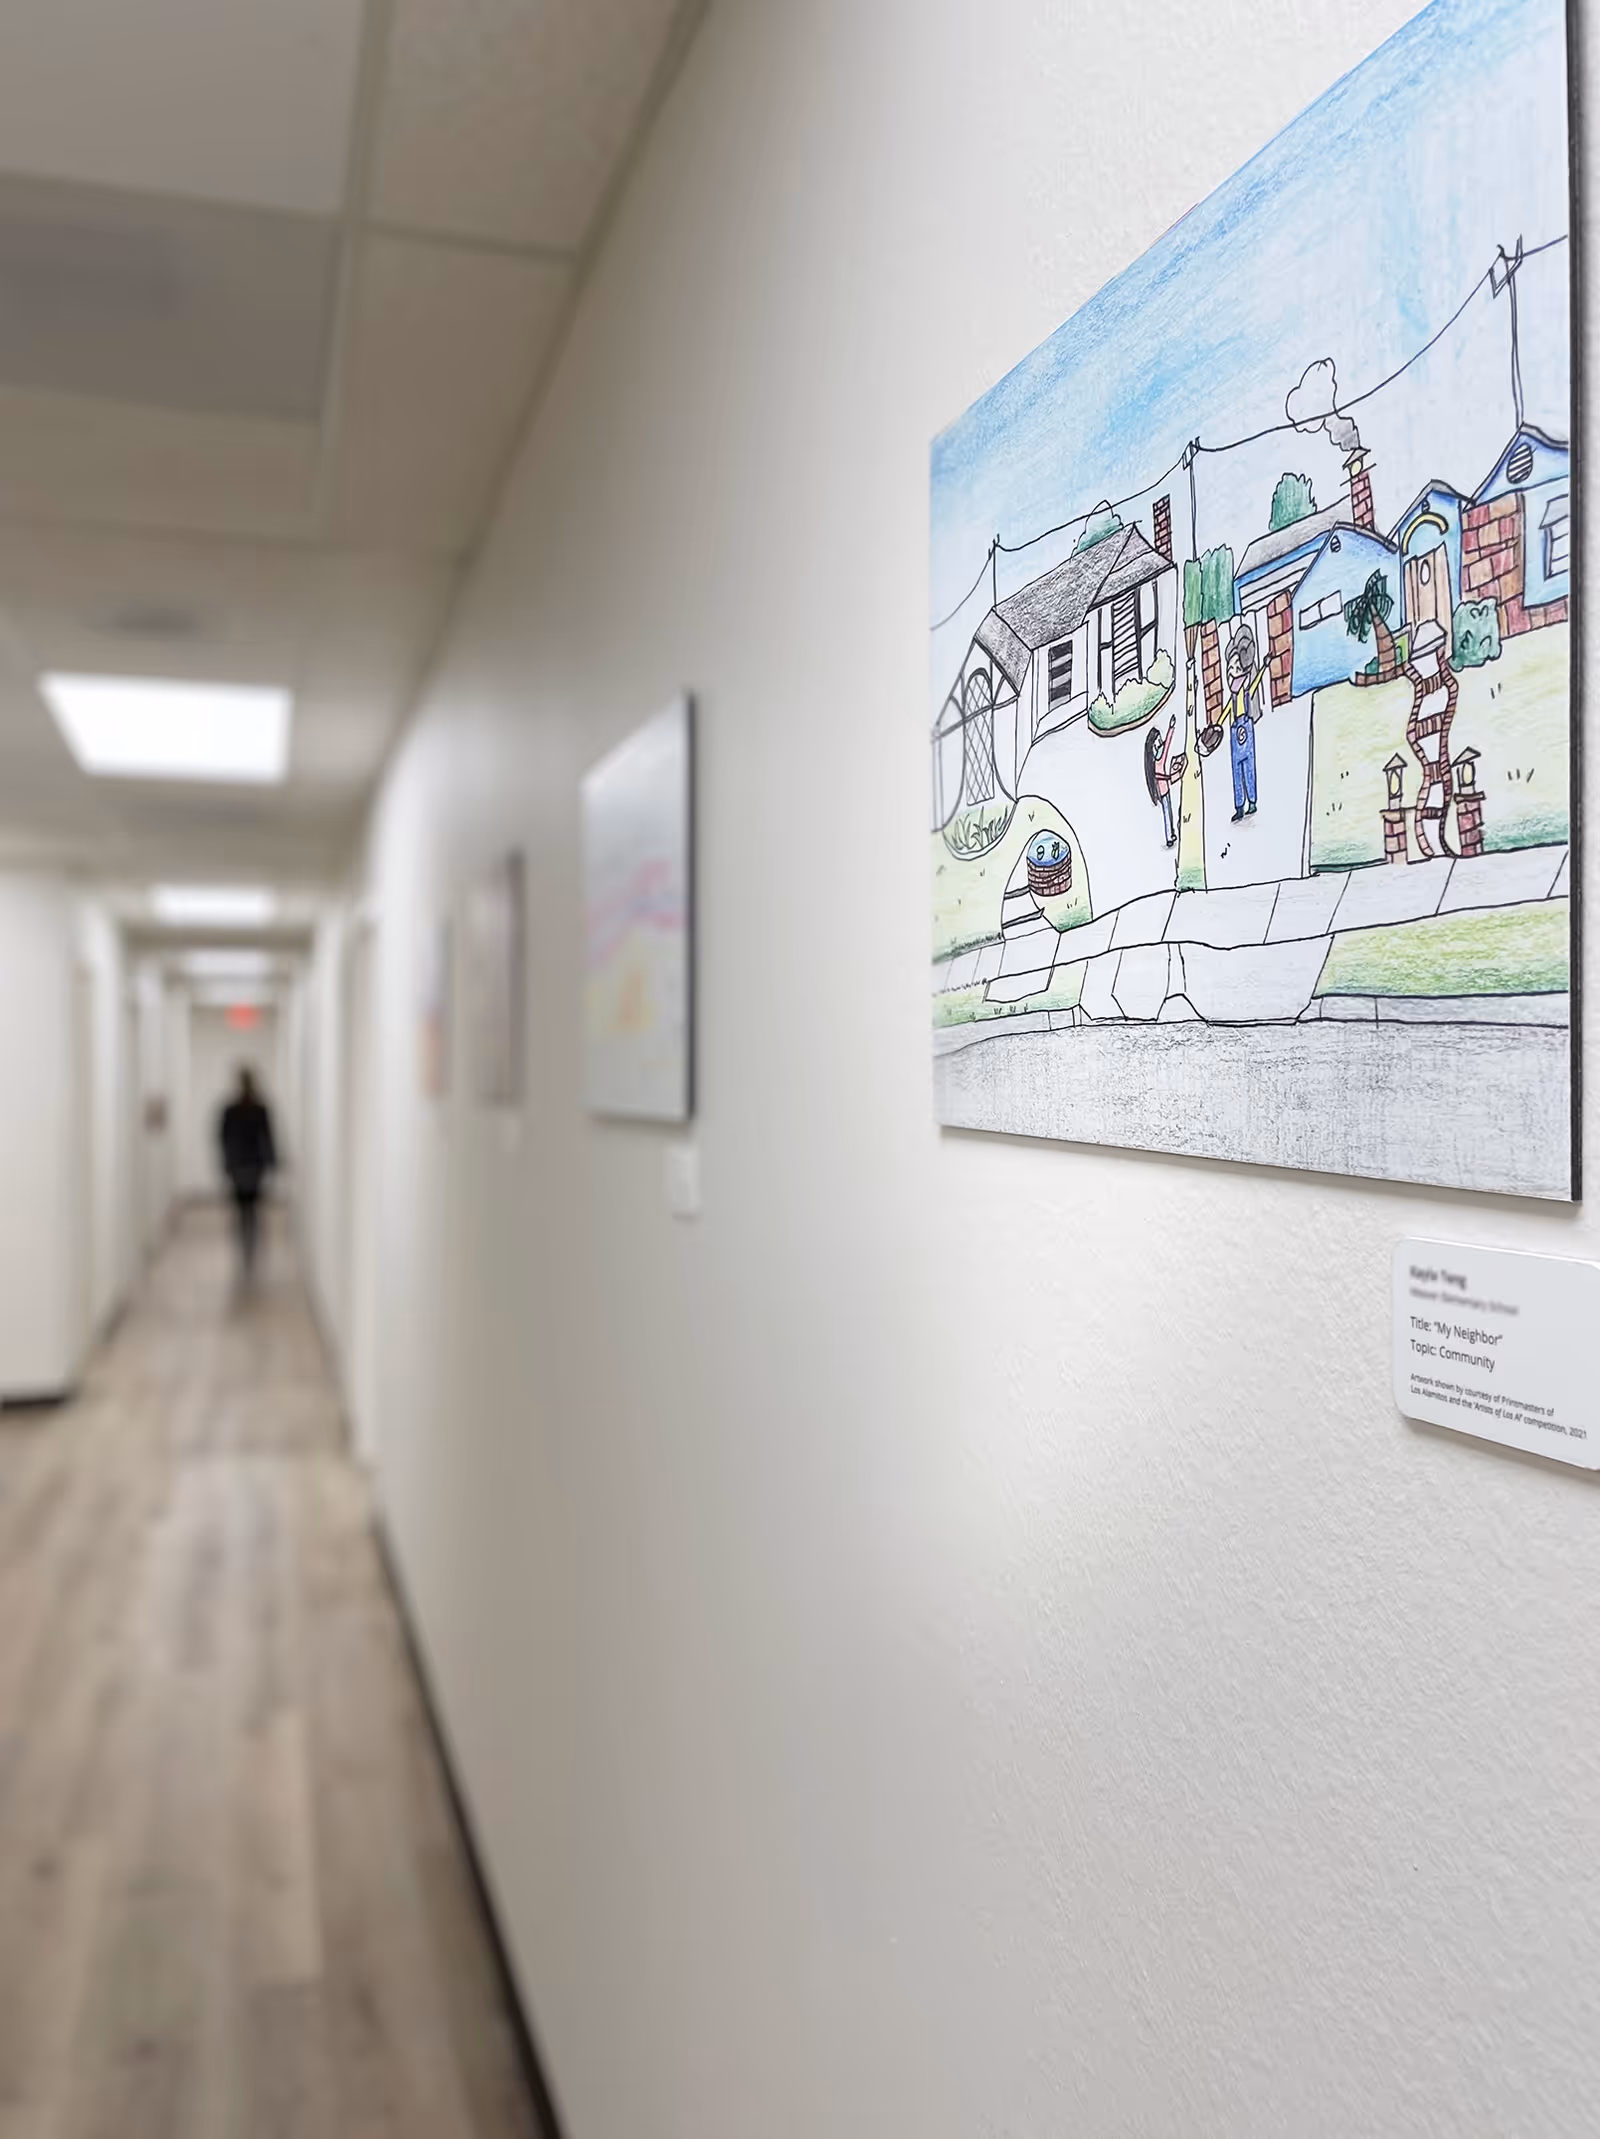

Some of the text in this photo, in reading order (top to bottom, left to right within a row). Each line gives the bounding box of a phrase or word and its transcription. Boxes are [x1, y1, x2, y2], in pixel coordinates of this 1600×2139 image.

[1410, 1315, 1503, 1346] Title: "My Neighbor"
[1410, 1338, 1495, 1373] Topic: Community
[1410, 1373, 1433, 1385] Artwork
[1435, 1379, 1455, 1391] shown
[1456, 1384, 1464, 1396] by
[1465, 1388, 1492, 1403] courtesy
[1493, 1394, 1501, 1403] of
[1547, 1407, 1555, 1417] of
[1410, 1384, 1421, 1395] Los
[1422, 1388, 1448, 1402] Alamitos
[1449, 1396, 1460, 1406] and
[1461, 1399, 1472, 1409] the
[1495, 1408, 1502, 1419] of
[1503, 1409, 1513, 1420] Los
[1569, 1426, 1587, 1439] 2021
